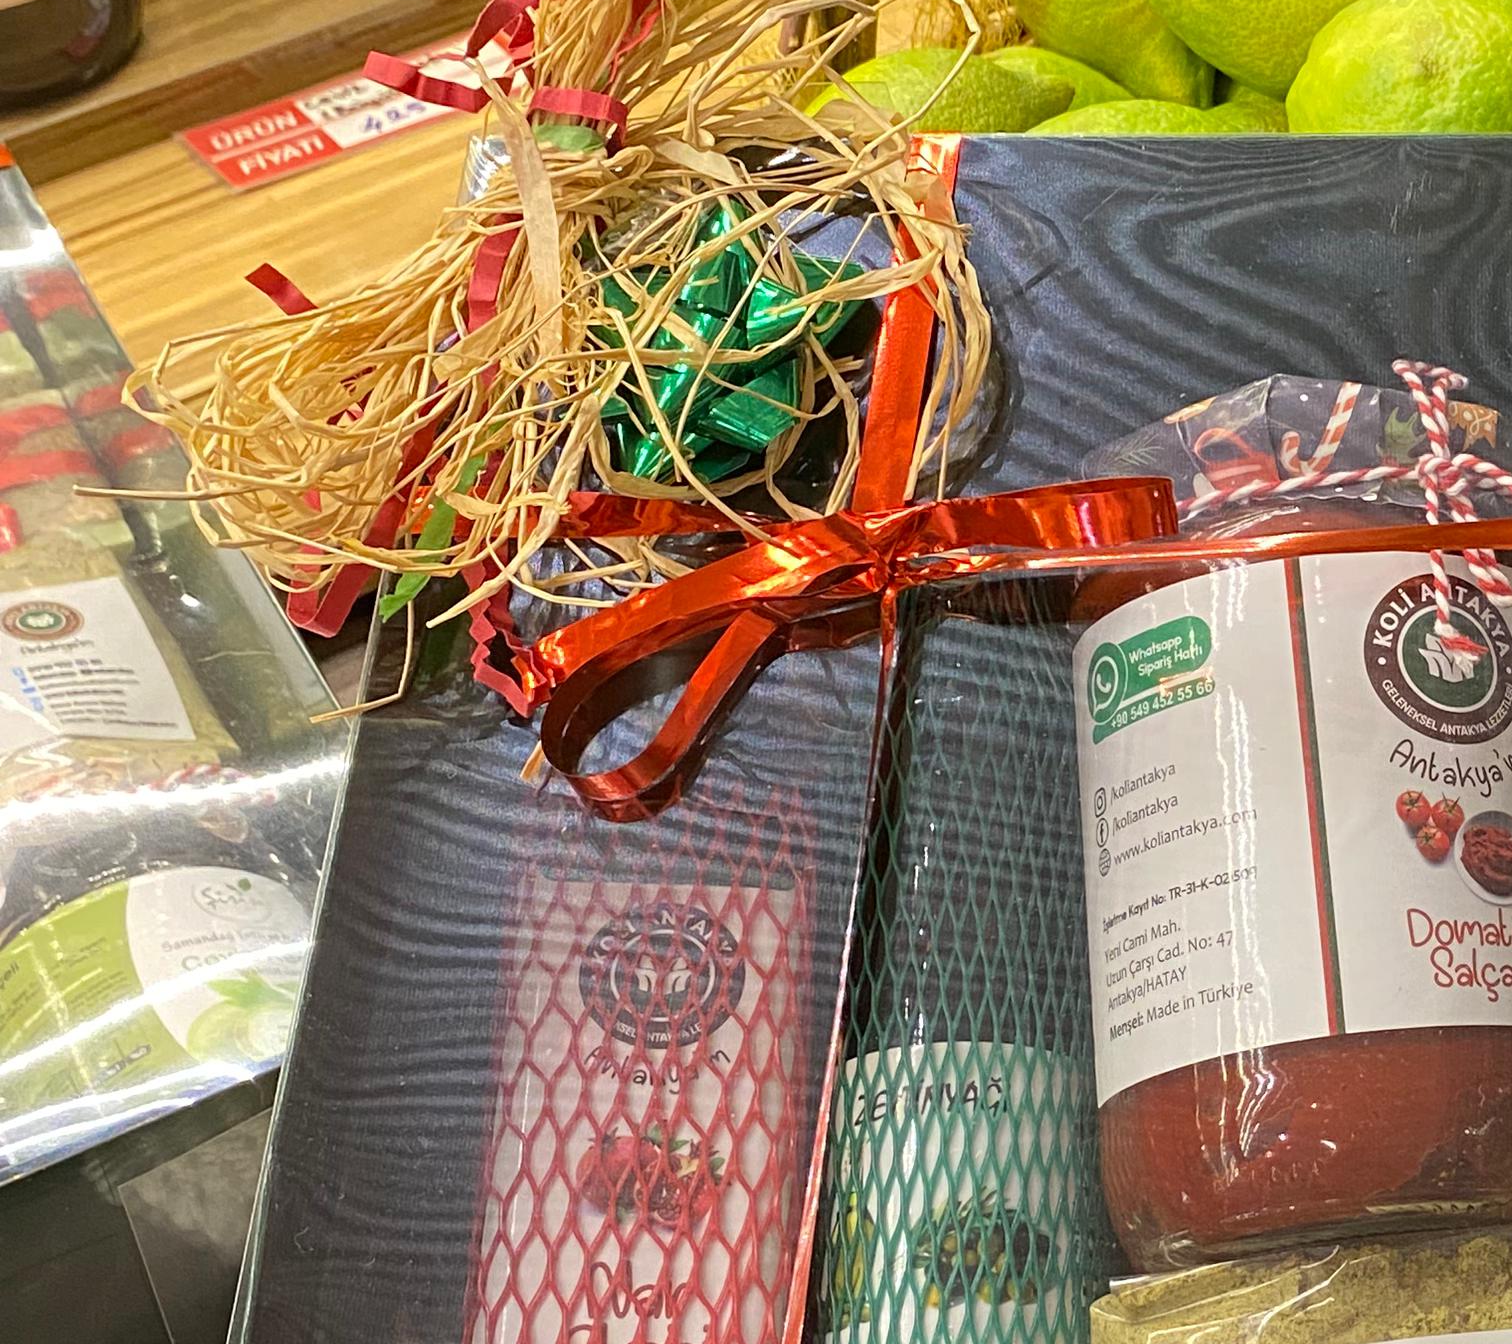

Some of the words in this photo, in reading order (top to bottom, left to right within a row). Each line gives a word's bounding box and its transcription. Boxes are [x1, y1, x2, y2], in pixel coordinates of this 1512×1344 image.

[209, 107, 299, 154] ÜRÜN
[238, 132, 325, 176] FİYATI
[1373, 588, 1415, 648] KOLİ
[1420, 582, 1511, 658] ATAKYA
[1129, 635, 1183, 664] Whatsapp
[1137, 654, 1172, 677] Sipariş
[1111, 711, 1128, 729] +90
[1131, 700, 1150, 721] 549
[1177, 684, 1193, 702] 55
[1196, 681, 1213, 694] 66
[1382, 679, 1438, 731] GELENEKSEL
[1440, 720, 1488, 736] ANTAKYA
[1104, 944, 1122, 964] Yeni
[1122, 933, 1148, 953] Cami
[1150, 918, 1181, 940] Mah.
[1105, 966, 1128, 988] Uzun
[1128, 954, 1154, 978] Çarşı
[1157, 943, 1185, 963] Cad.
[1188, 936, 1213, 953] No:
[1216, 930, 1234, 947] 47
[1108, 966, 1188, 1012] Antakya/HATAY
[1146, 999, 1180, 1022] Made
[1183, 995, 1195, 1008] in
[1198, 981, 1254, 1004] Türkiye
